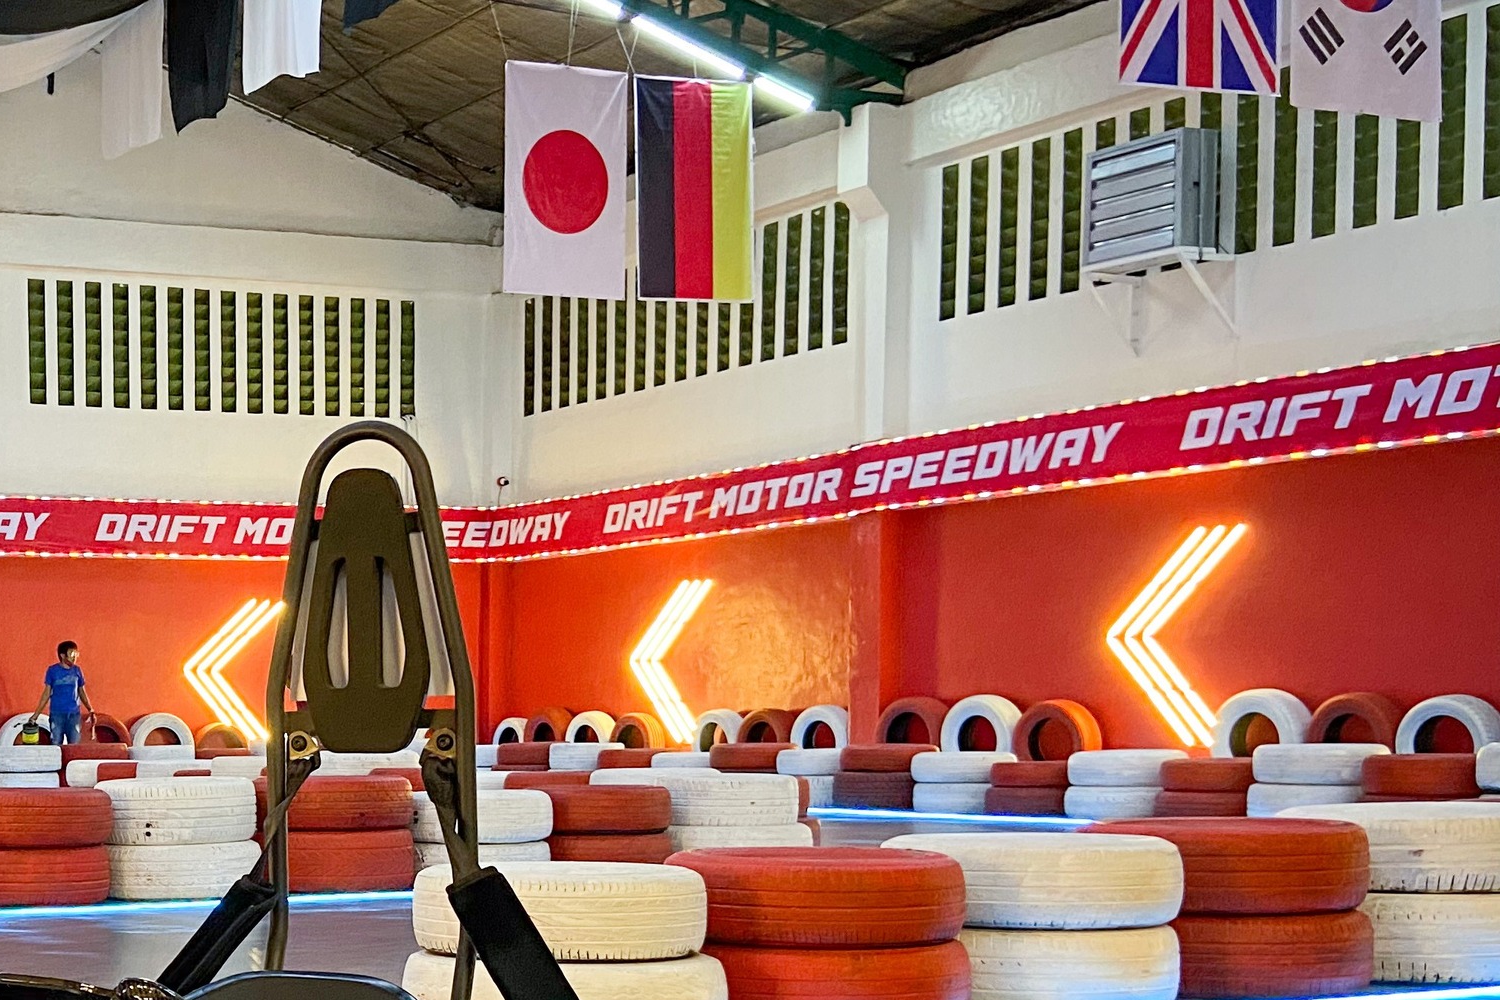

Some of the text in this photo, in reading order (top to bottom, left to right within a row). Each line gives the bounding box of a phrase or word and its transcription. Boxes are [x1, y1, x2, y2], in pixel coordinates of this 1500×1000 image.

[1178, 365, 1500, 451] DRIFT MO
[602, 421, 1125, 534] DRIFT MOTOR SPEEDWAY
[95, 513, 227, 543] DRIFT
[440, 510, 572, 548] EEDWAY
